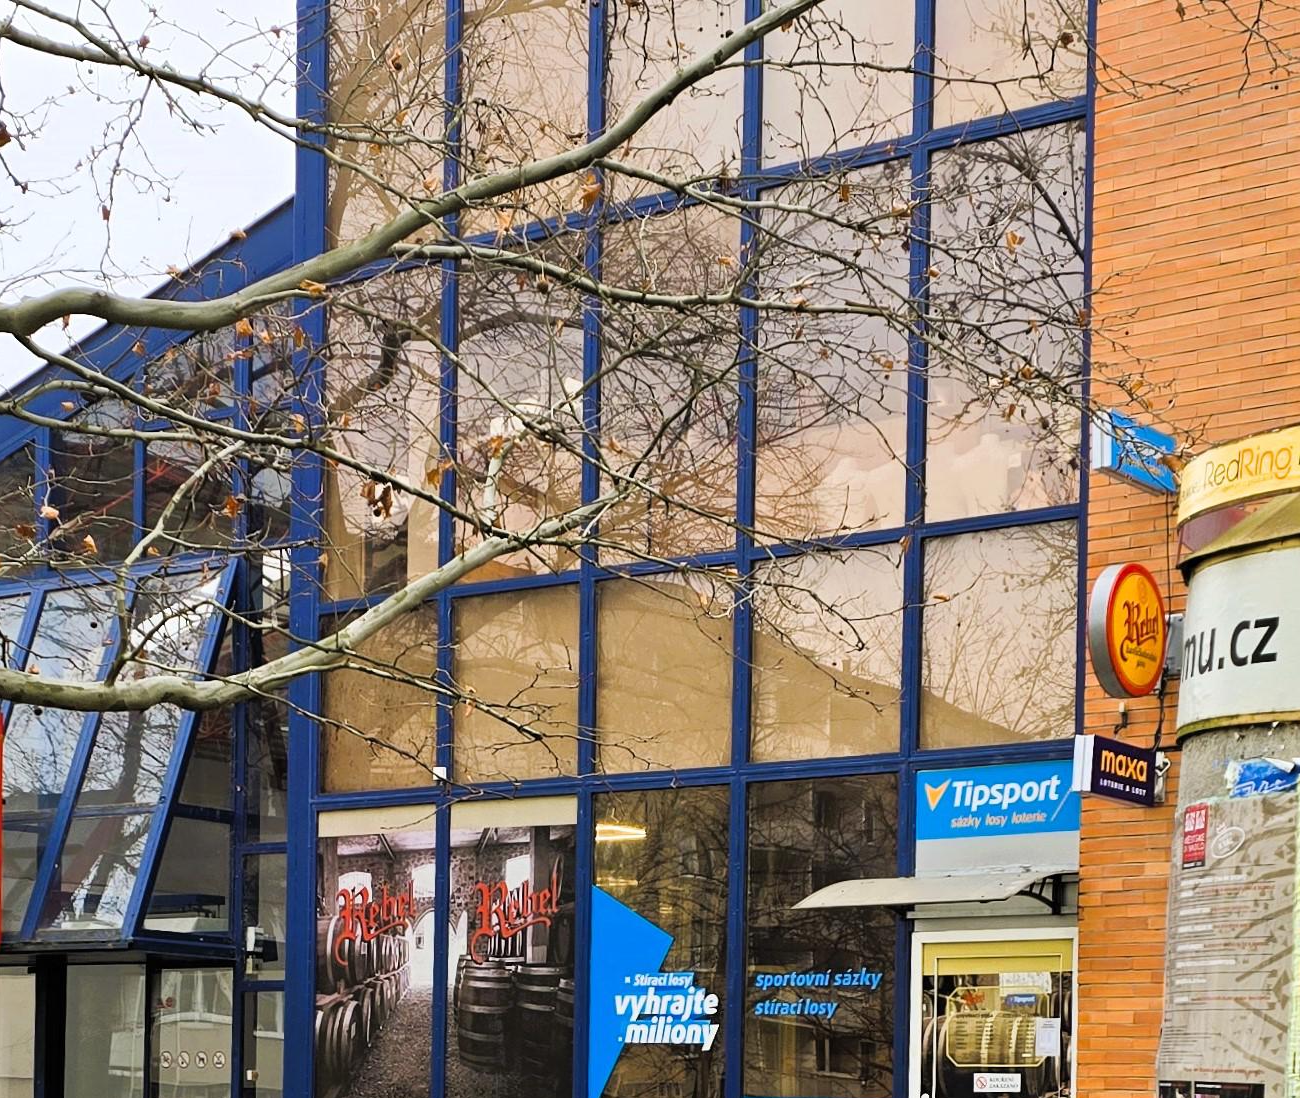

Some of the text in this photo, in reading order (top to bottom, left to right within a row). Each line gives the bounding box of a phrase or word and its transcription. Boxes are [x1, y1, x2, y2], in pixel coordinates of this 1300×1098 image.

[1203, 445, 1294, 488] RedRing
[1120, 600, 1160, 662] Rebel
[1100, 750, 1148, 783] maxa
[951, 775, 1061, 813] Tipsport
[1099, 778, 1124, 792] LOTERIE
[950, 811, 1047, 830] sázky losy loterie
[633, 973, 667, 987] Stírací
[754, 967, 883, 991] sportovní sázky
[614, 987, 719, 1022] vyhrajte
[754, 998, 839, 1020] stírací losy
[624, 1017, 720, 1052] miliony
